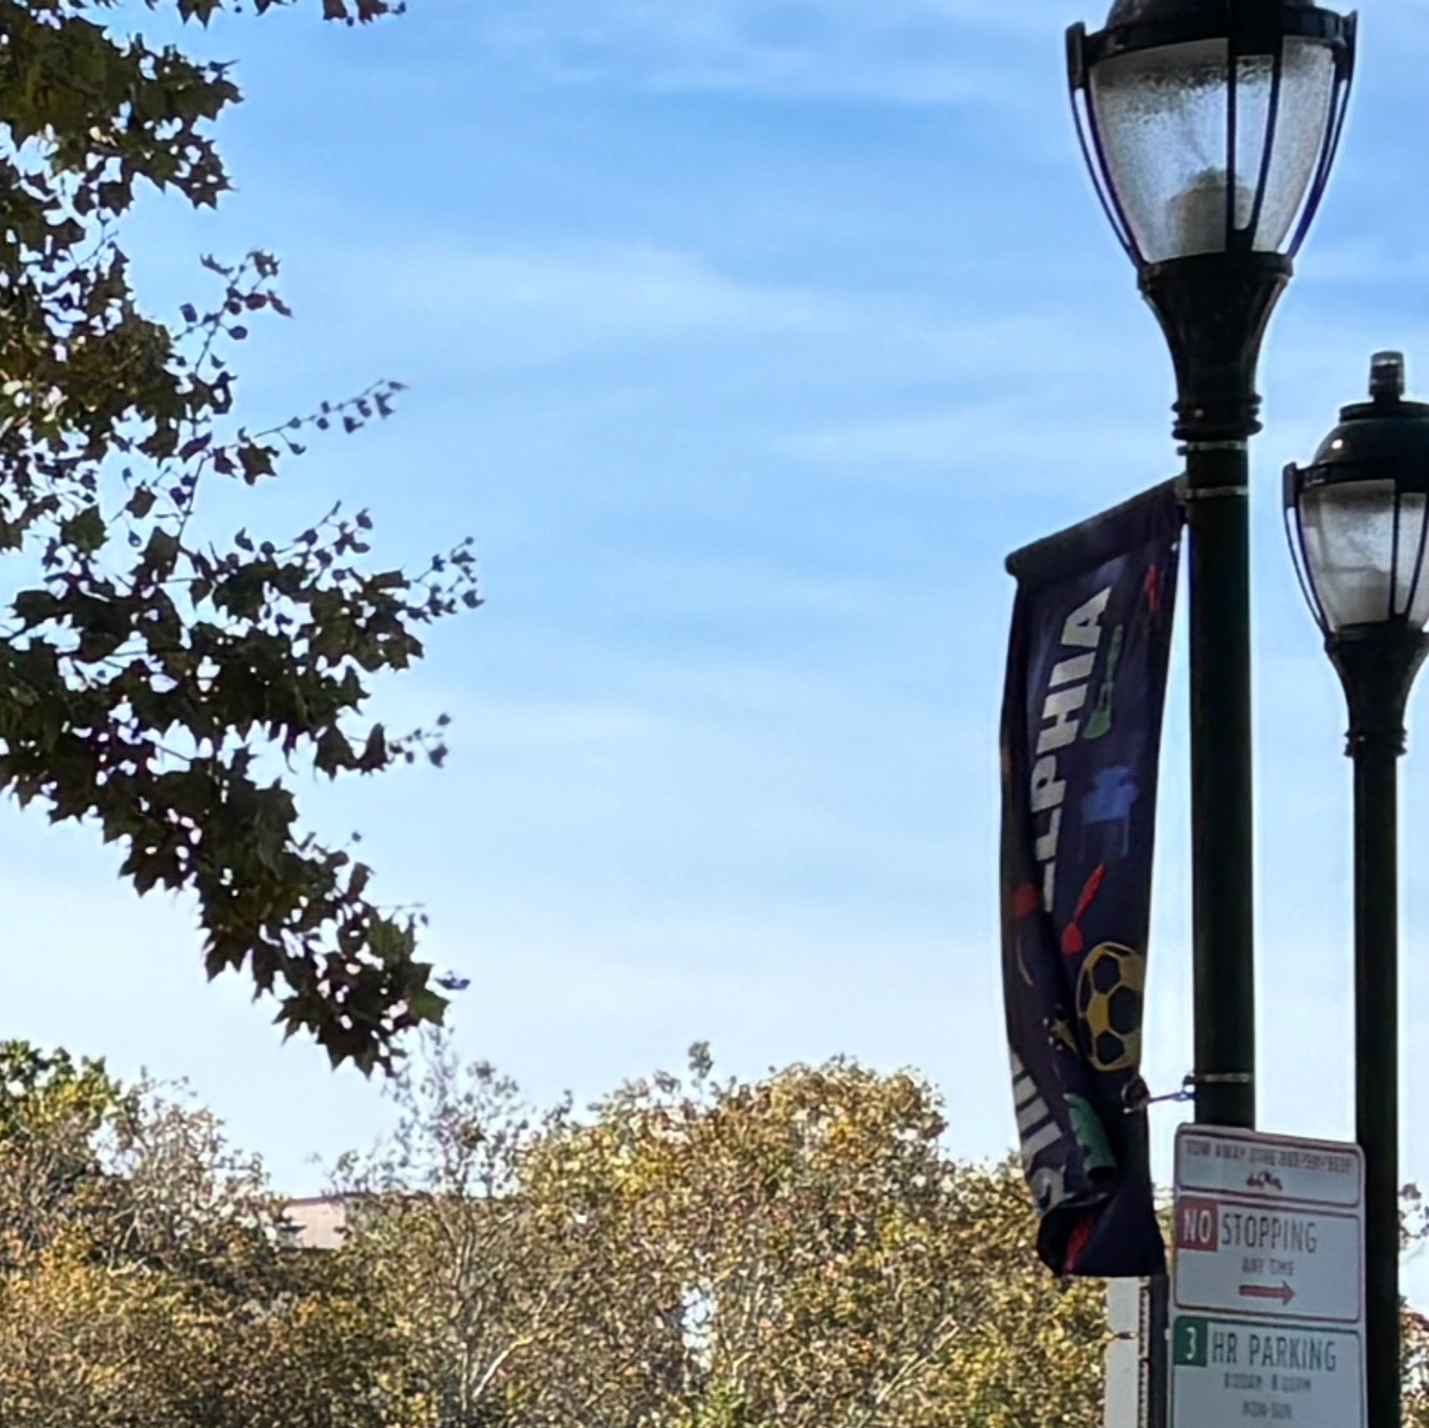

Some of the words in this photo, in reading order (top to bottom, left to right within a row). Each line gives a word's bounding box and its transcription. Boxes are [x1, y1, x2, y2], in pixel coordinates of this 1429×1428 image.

[1183, 1209, 1212, 1244] NO
[1221, 1213, 1317, 1254] STOPPING
[1185, 1326, 1197, 1360] 3
[1212, 1332, 1238, 1364] HR
[1248, 1334, 1337, 1372] PARKING
